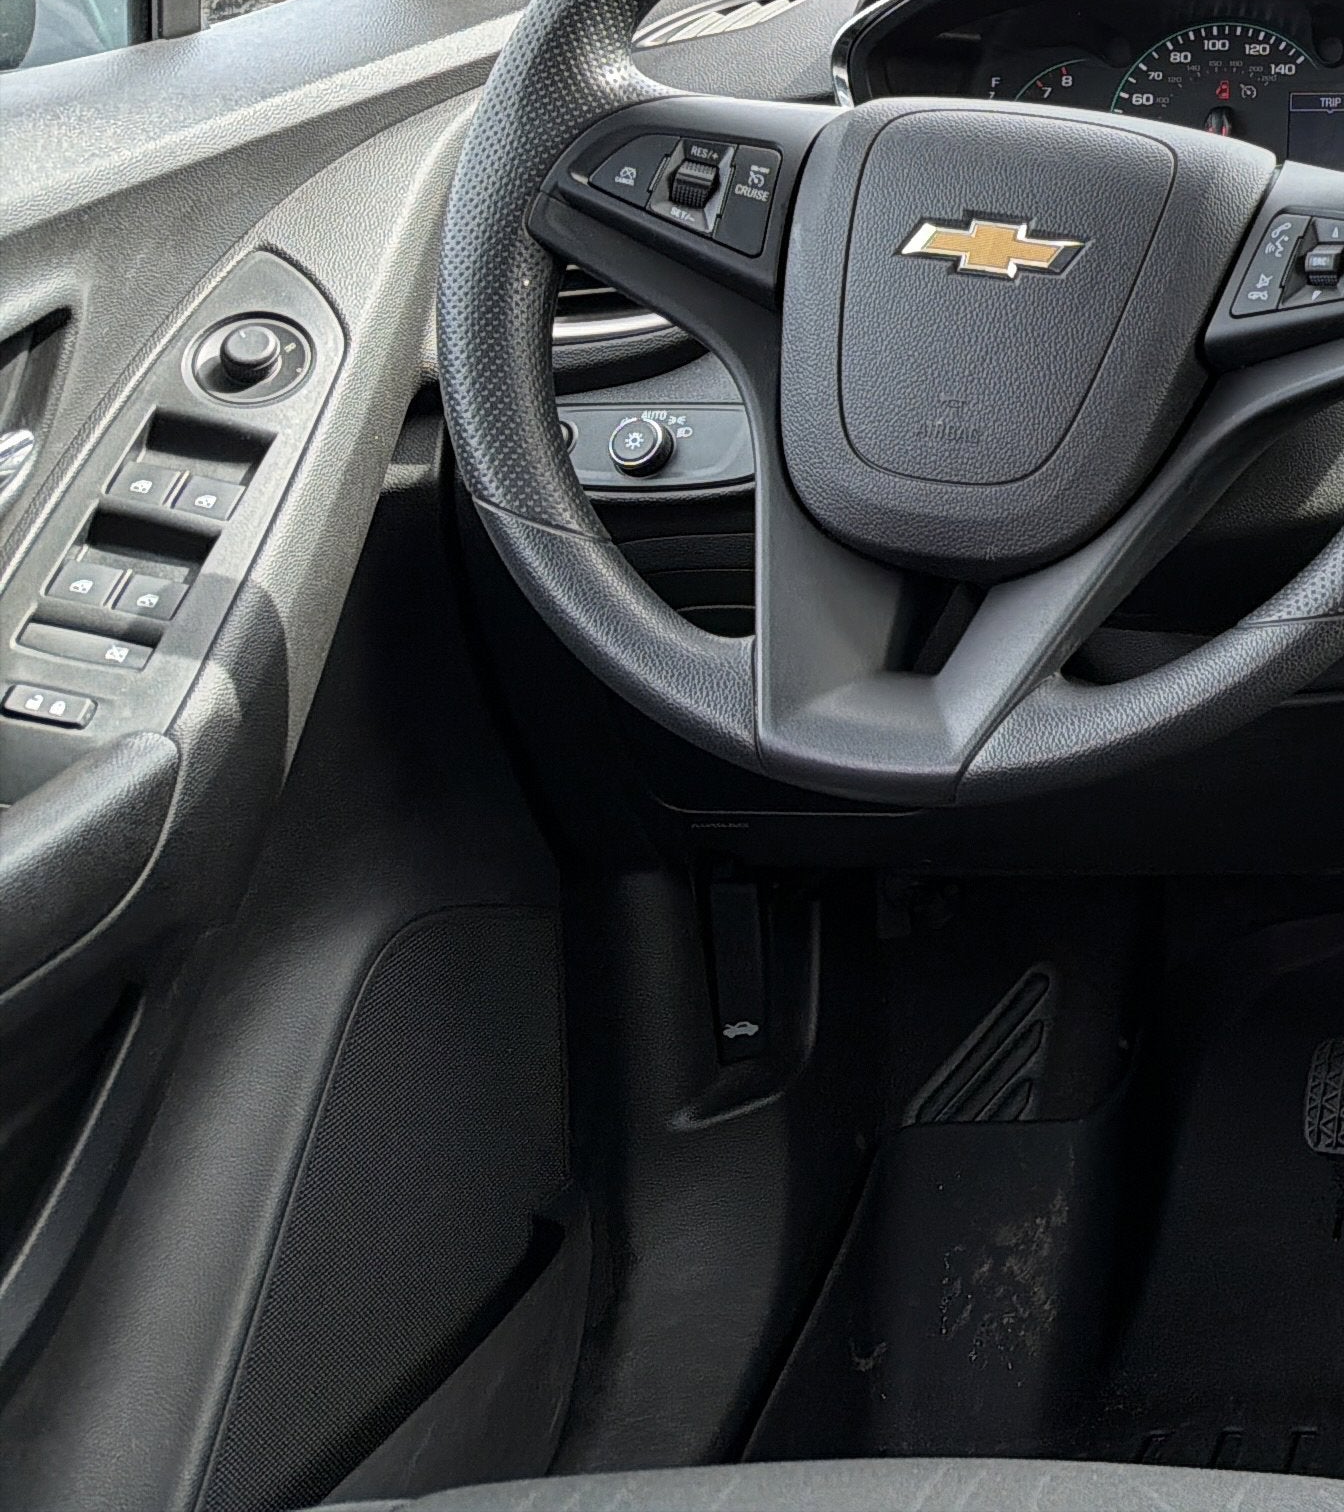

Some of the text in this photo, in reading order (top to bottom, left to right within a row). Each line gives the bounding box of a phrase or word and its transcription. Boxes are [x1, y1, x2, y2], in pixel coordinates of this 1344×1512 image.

[1204, 40, 1229, 51] 100
[1245, 44, 1270, 55] 120
[1170, 52, 1191, 63] 80
[1270, 64, 1296, 75] 140
[1061, 76, 1072, 87] 8
[1148, 72, 1163, 80] 70
[991, 77, 1000, 87] F
[1042, 87, 1052, 98] 7
[1132, 94, 1154, 105] 60
[1320, 97, 1342, 108] TRIP
[690, 145, 719, 159] RES/+
[734, 184, 770, 202] CRUISE
[641, 410, 667, 421] AUTO
